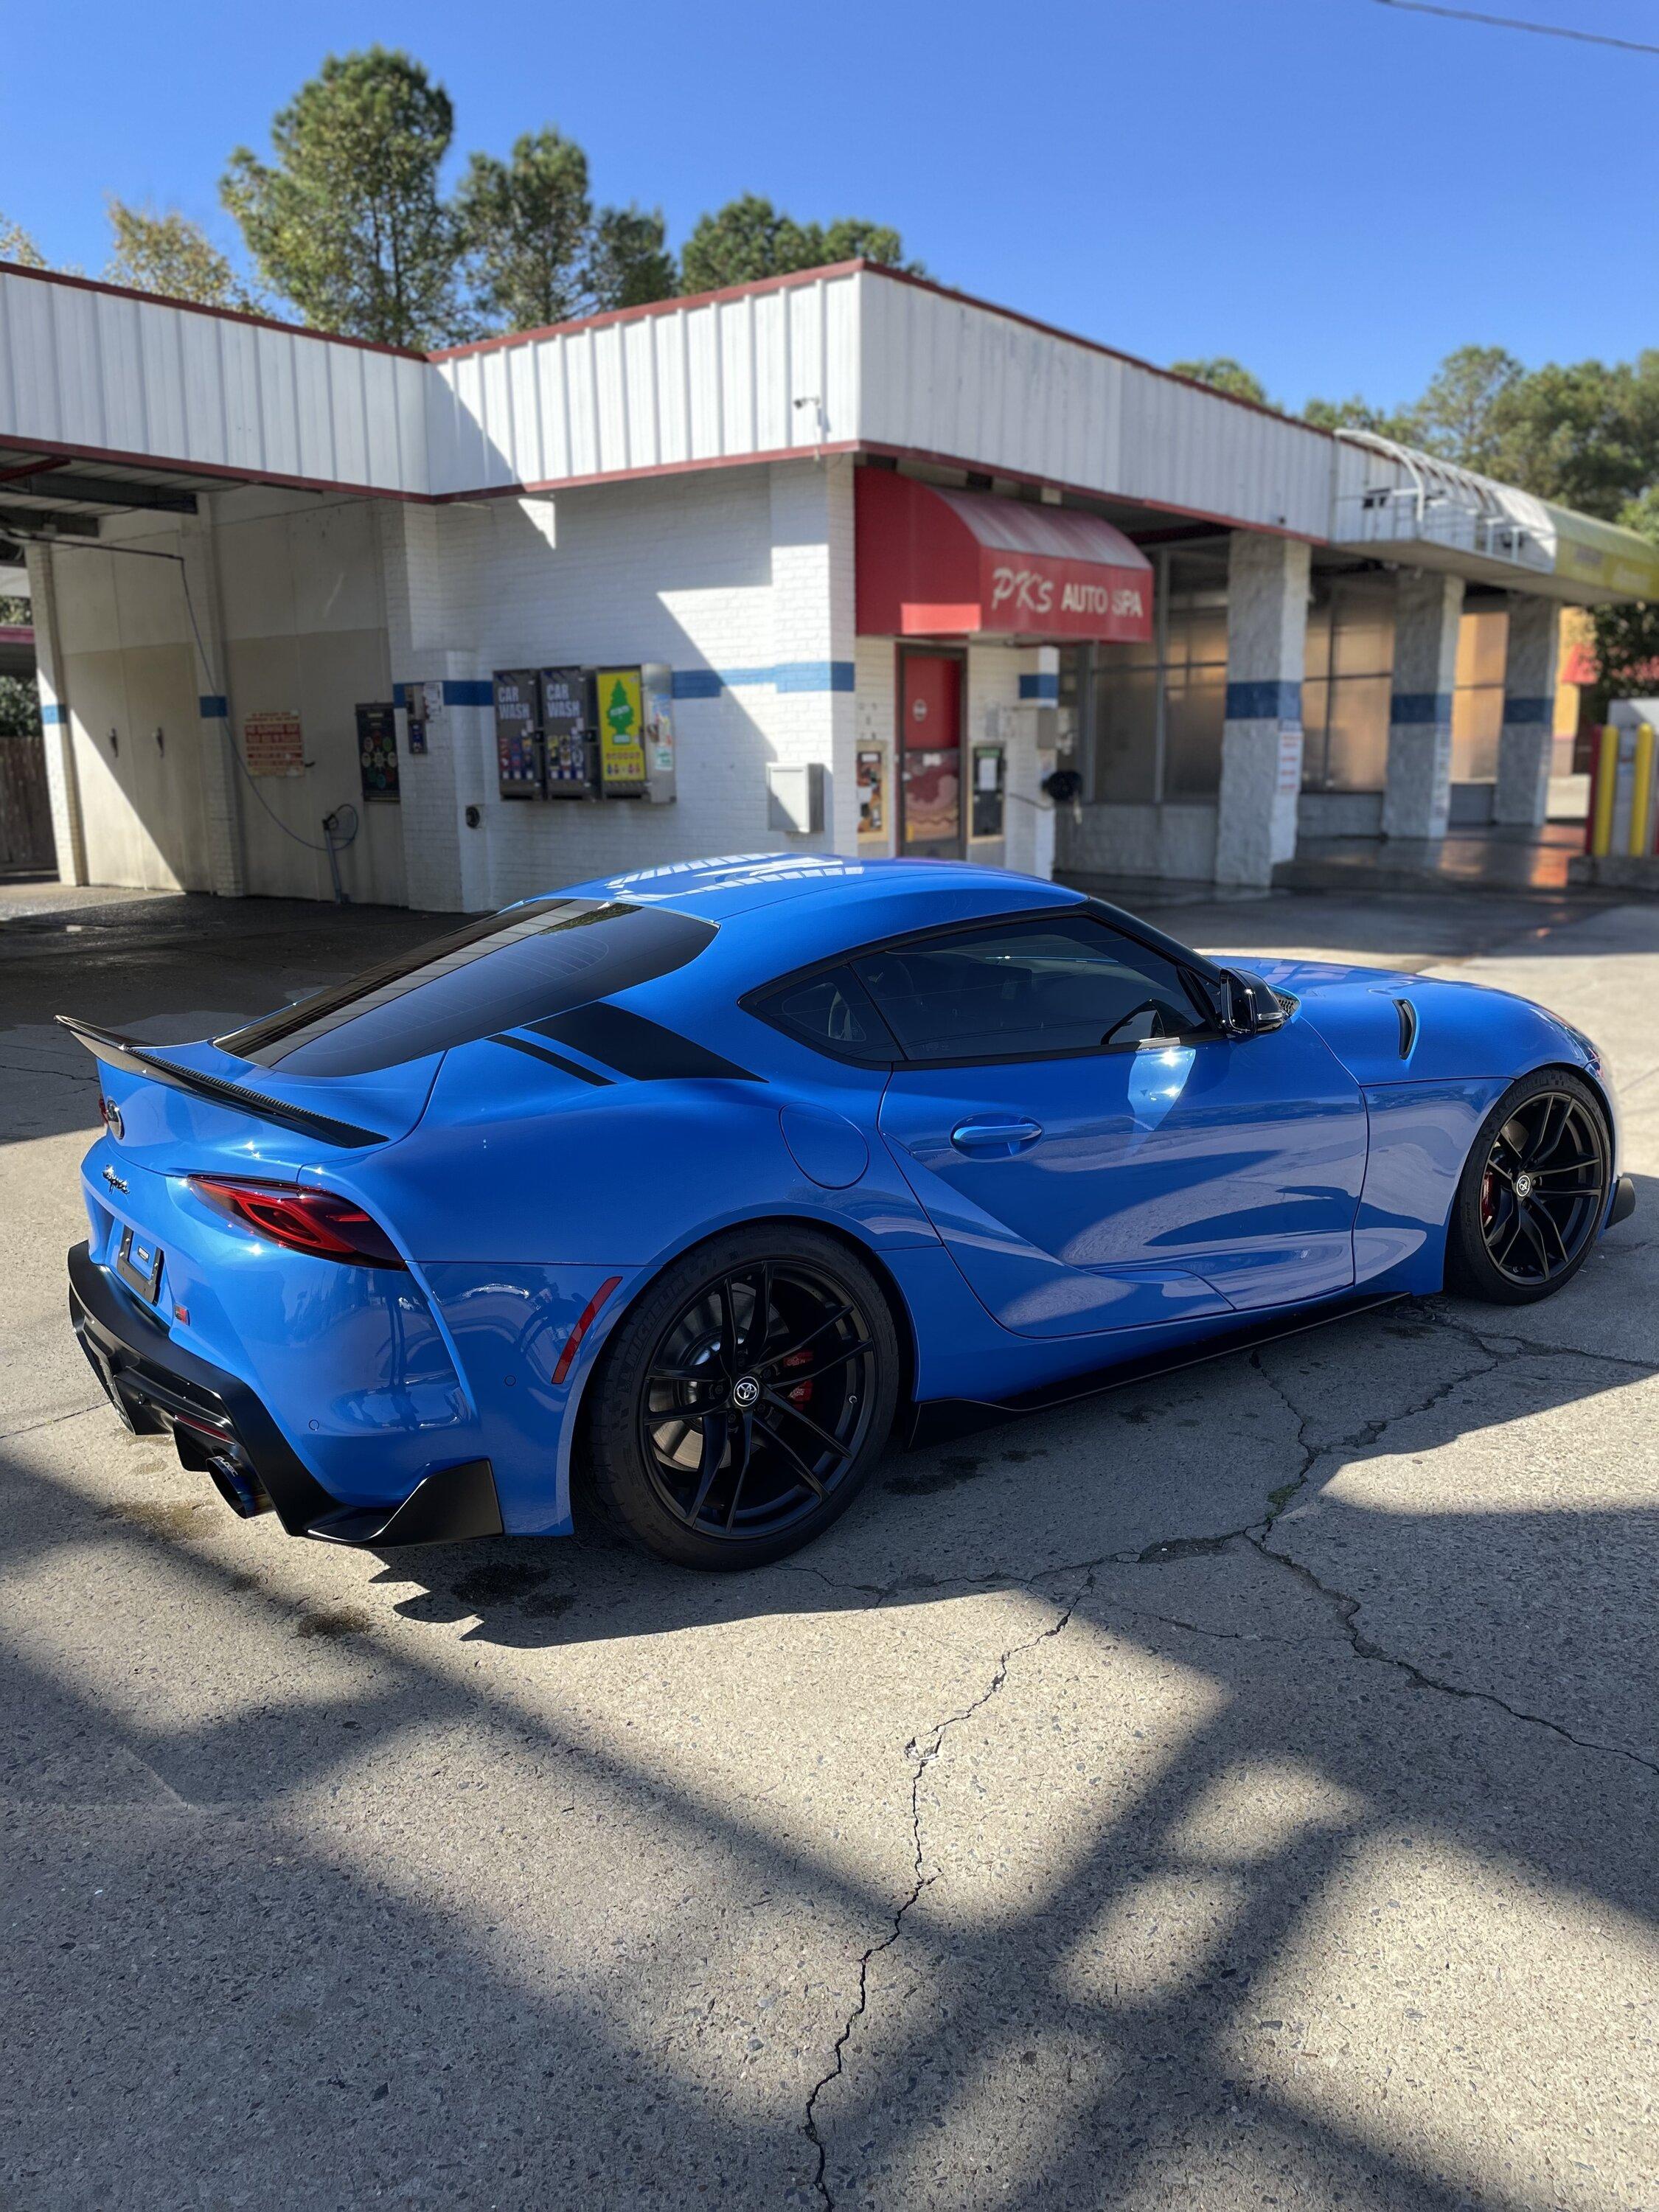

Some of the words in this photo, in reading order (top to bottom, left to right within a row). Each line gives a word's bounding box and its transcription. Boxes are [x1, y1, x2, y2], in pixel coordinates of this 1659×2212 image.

[1061, 583, 1108, 613] AUTO
[1112, 590, 1144, 617] SPA
[498, 686, 519, 702] CAR
[546, 683, 569, 700] CAR
[499, 703, 530, 720] WASH
[548, 700, 580, 718] WASH
